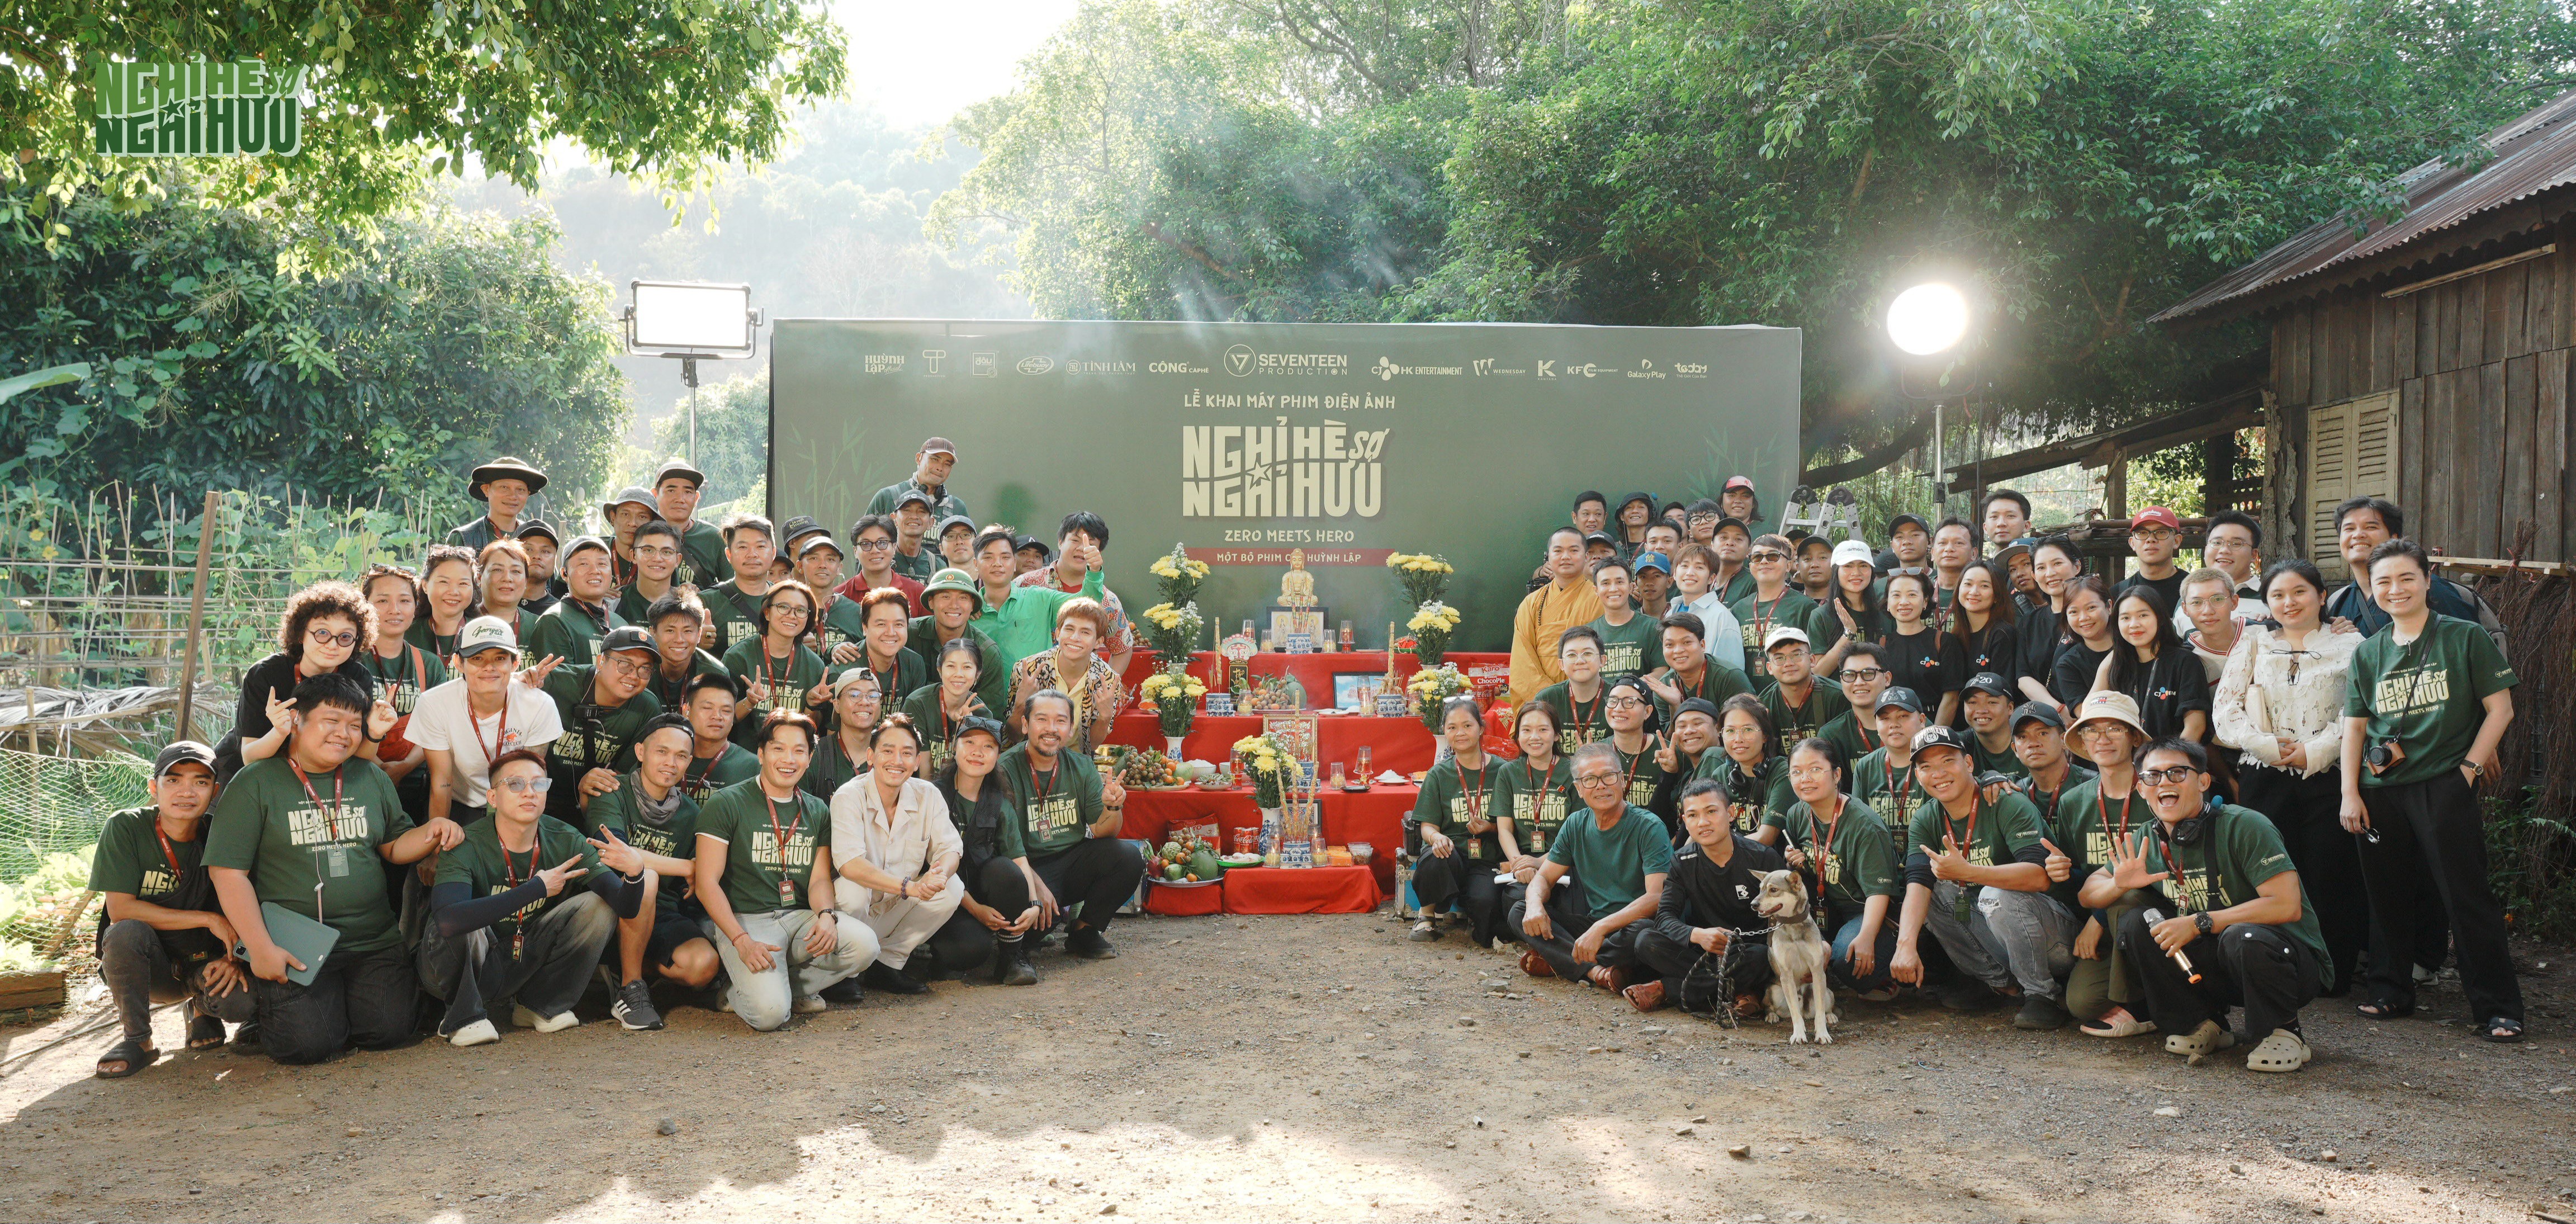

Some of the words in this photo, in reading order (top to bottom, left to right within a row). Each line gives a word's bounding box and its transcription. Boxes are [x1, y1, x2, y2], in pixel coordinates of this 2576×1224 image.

[1258, 353, 1347, 367] SEVENTEEN
[1148, 360, 1187, 374] CỘNG
[1401, 366, 1414, 375] HK
[1415, 366, 1462, 375] ENTERTAINMENT
[1674, 362, 1707, 374] today
[1627, 371, 1651, 380] Galaxy
[1651, 371, 1666, 380] Play
[1184, 388, 1201, 408] LỄ
[1206, 394, 1240, 408] KHAI
[1247, 391, 1275, 408] MÁY
[1281, 394, 1318, 409] PHIM
[1324, 393, 1359, 411] ĐIỆN
[1364, 391, 1395, 409] ẢNH
[1182, 416, 1287, 478] NGHỈ
[1293, 419, 1347, 460] HÈ
[1292, 459, 1381, 518] HƯU
[1224, 530, 1261, 542] ZERO
[1266, 530, 1311, 543] MEETS
[1315, 530, 1355, 542] HERO
[1216, 552, 1237, 563] MỘT
[1240, 551, 1254, 564] BỘ
[1257, 553, 1282, 563] PHIM
[1307, 551, 1339, 563] HUỲNH
[1343, 551, 1361, 564] LẬP
